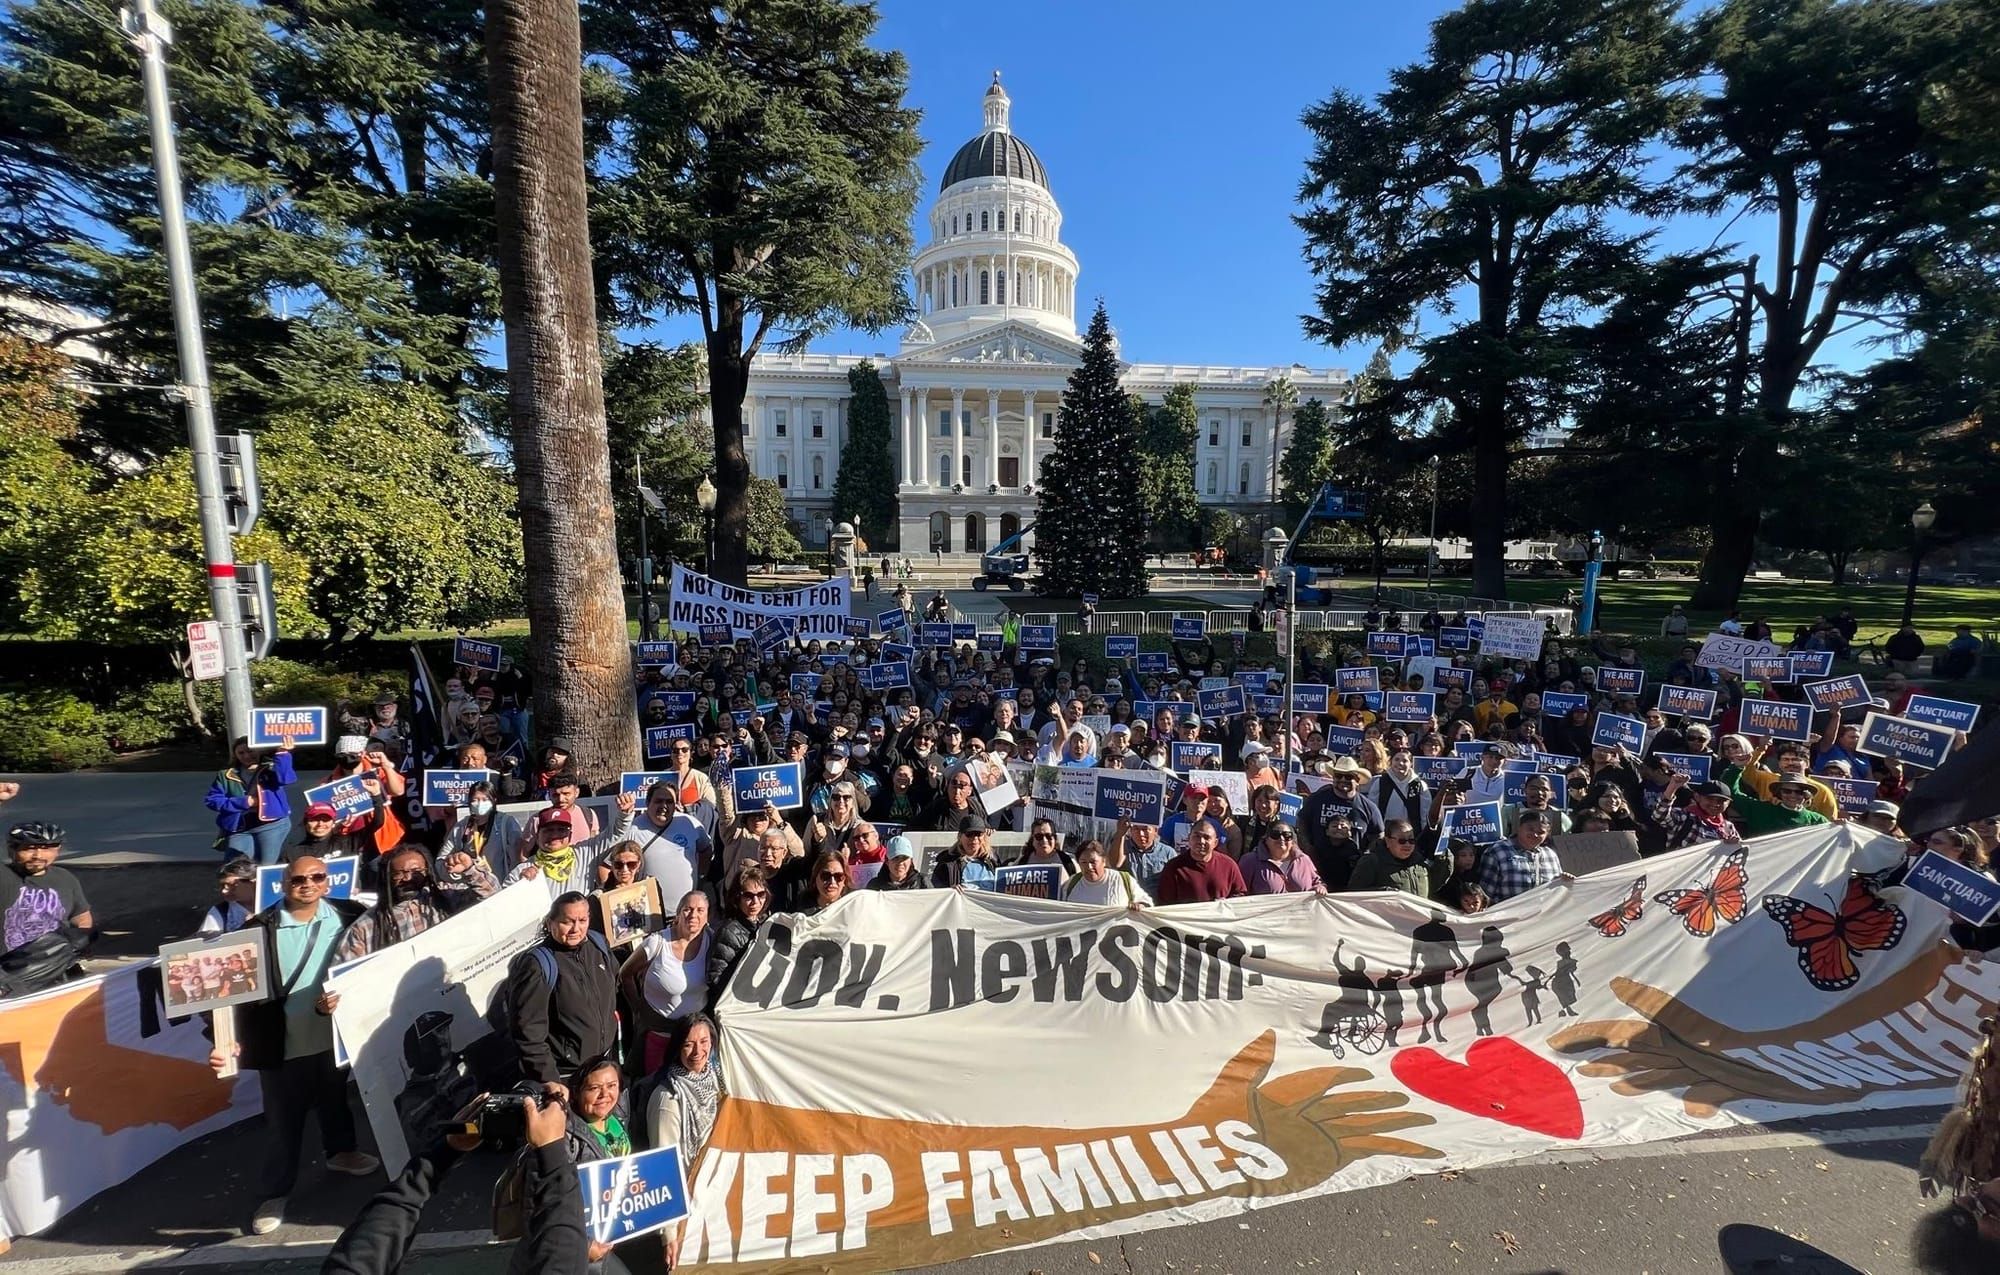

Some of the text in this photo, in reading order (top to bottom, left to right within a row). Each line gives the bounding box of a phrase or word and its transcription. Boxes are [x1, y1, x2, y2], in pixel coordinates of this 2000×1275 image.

[682, 573, 841, 607] NOT ONE CENT FOR
[673, 601, 727, 625] MASS
[733, 610, 848, 634] DEPATION
[703, 625, 726, 634] WE ARE
[1174, 627, 1200, 635] CALIFORNIA
[1374, 635, 1399, 643] WE ARE
[462, 640, 493, 655] WE ARE
[655, 644, 668, 652] ARE
[1718, 640, 1770, 657] STOP
[461, 651, 493, 664] HUMAN
[1793, 654, 1823, 663] WE ARE
[883, 665, 894, 673] ICE
[1750, 660, 1784, 668] WE ARE
[1342, 670, 1370, 679] WE ARE
[1439, 669, 1465, 678] WE ARE
[1604, 670, 1634, 681] WE ARE
[1750, 668, 1785, 677] HUMAN
[874, 674, 905, 683] CALIFORNIA
[1343, 678, 1372, 688] HUMAN
[1603, 678, 1635, 688] HUMAN
[1812, 680, 1853, 694] WE ARE
[1214, 691, 1227, 699] ICE
[1403, 695, 1417, 703] ICE
[1669, 688, 1705, 702] WE ARE
[1817, 688, 1859, 704] HUMAN
[1203, 699, 1239, 711] CALIFORNIA
[1390, 705, 1427, 714] CALIFORNIA
[1667, 698, 1705, 711] HUMAN
[1751, 703, 1798, 719] WE ARE
[1911, 704, 1970, 721] SANCTUARY
[264, 712, 313, 724] WE ARE
[1750, 714, 1798, 731] HUMAN
[264, 723, 315, 736] HUMAN
[1617, 720, 1631, 730] ICE
[654, 727, 686, 740] WE ARE
[1599, 728, 1639, 745] CALIFORNIA
[1886, 723, 1930, 742] MAGA
[1179, 745, 1212, 756] WE ARE
[1871, 734, 1935, 758] CALIFORNIA
[1179, 755, 1201, 766] HUM
[1460, 752, 1482, 761] SANCT
[1540, 755, 1553, 764] WE
[1673, 757, 1689, 765] ICE
[1431, 761, 1447, 769] ICE
[758, 771, 777, 780] ICE
[643, 777, 659, 786] ICE
[754, 780, 769, 788] OUT
[1166, 778, 1178, 790] RE
[1833, 782, 1853, 791] ICE
[332, 782, 354, 795] ICE
[741, 786, 793, 800] CALIFORNIA
[331, 788, 360, 802] OUT OF
[448, 793, 466, 802] ICE
[1103, 788, 1157, 804] CALIFORNIA
[1836, 795, 1868, 806] FORNIA
[1126, 801, 1143, 809] OUT
[1326, 804, 1353, 813] JUST
[1118, 807, 1137, 819] ICE
[1465, 809, 1482, 818] ICE
[1461, 818, 1474, 826] OUT
[1450, 823, 1497, 836] CALIFORNIA
[1005, 870, 1049, 885] WE ARE
[1004, 884, 1049, 898] HUMAN
[1918, 865, 1993, 907] SANCTUARY
[474, 957, 486, 967] dad
[492, 949, 501, 957] my
[485, 962, 495, 971] life
[731, 920, 900, 1012] Gov.
[629, 1180, 647, 1195] OF
[678, 1119, 1290, 1267] KEEP FAMILIES
